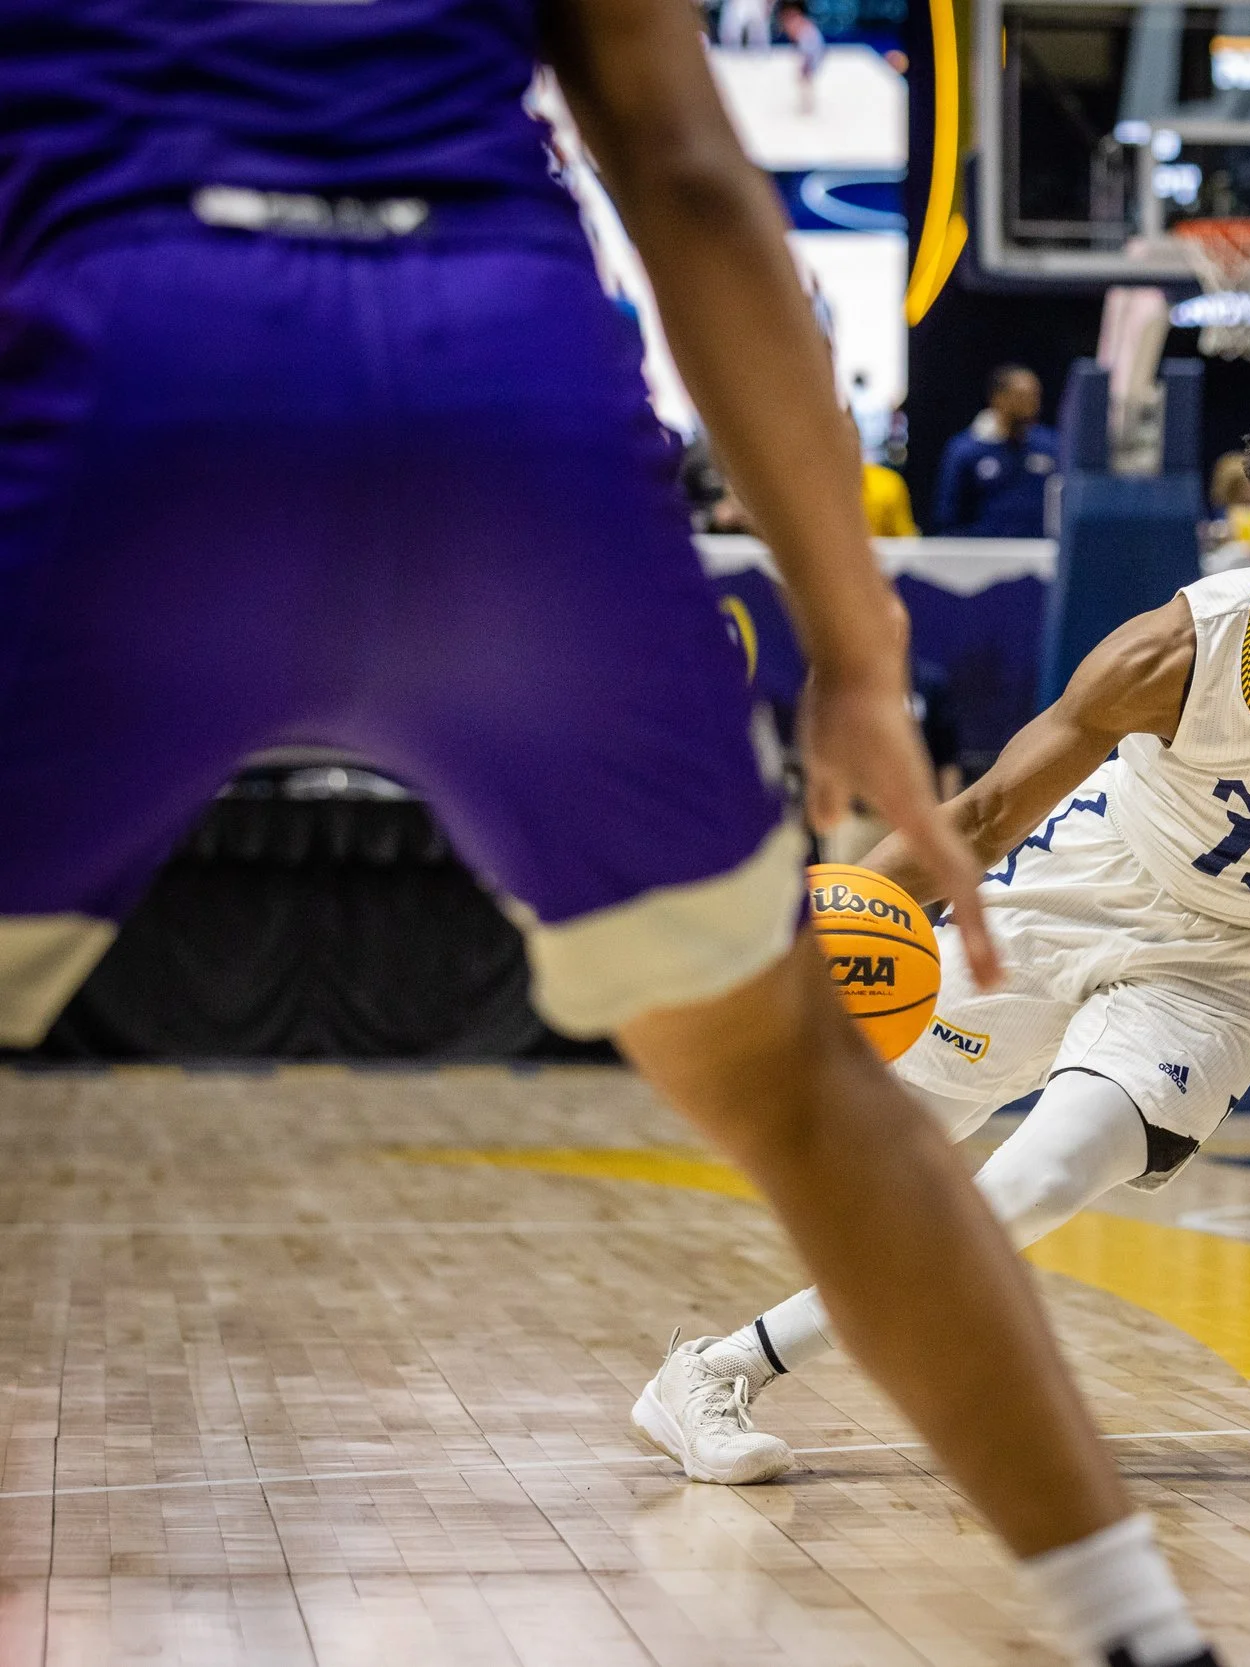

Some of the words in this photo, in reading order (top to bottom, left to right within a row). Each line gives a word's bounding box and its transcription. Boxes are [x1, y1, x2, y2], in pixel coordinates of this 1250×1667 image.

[812, 884, 913, 932] ilson
[828, 956, 895, 987] CAA
[932, 1023, 982, 1055] NAU
[1158, 1062, 1187, 1095] adidas
